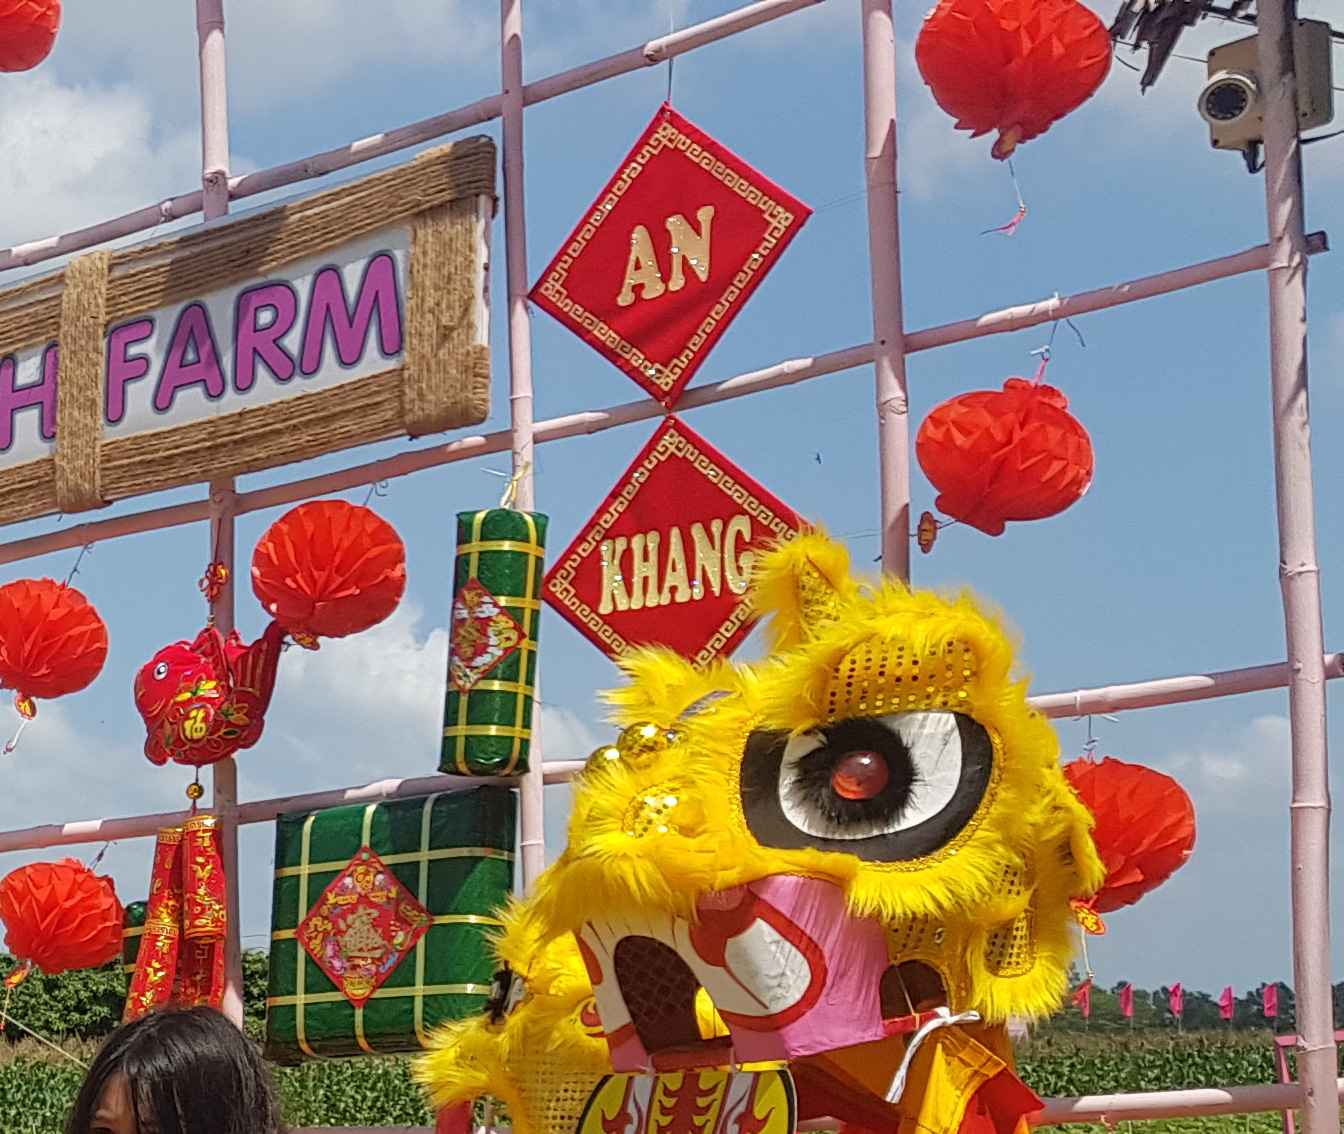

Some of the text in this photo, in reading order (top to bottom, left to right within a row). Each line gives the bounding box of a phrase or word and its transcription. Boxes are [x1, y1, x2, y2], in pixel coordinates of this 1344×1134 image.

[617, 206, 715, 306] AN
[105, 251, 404, 425] FARM
[598, 514, 756, 614] KHANG
